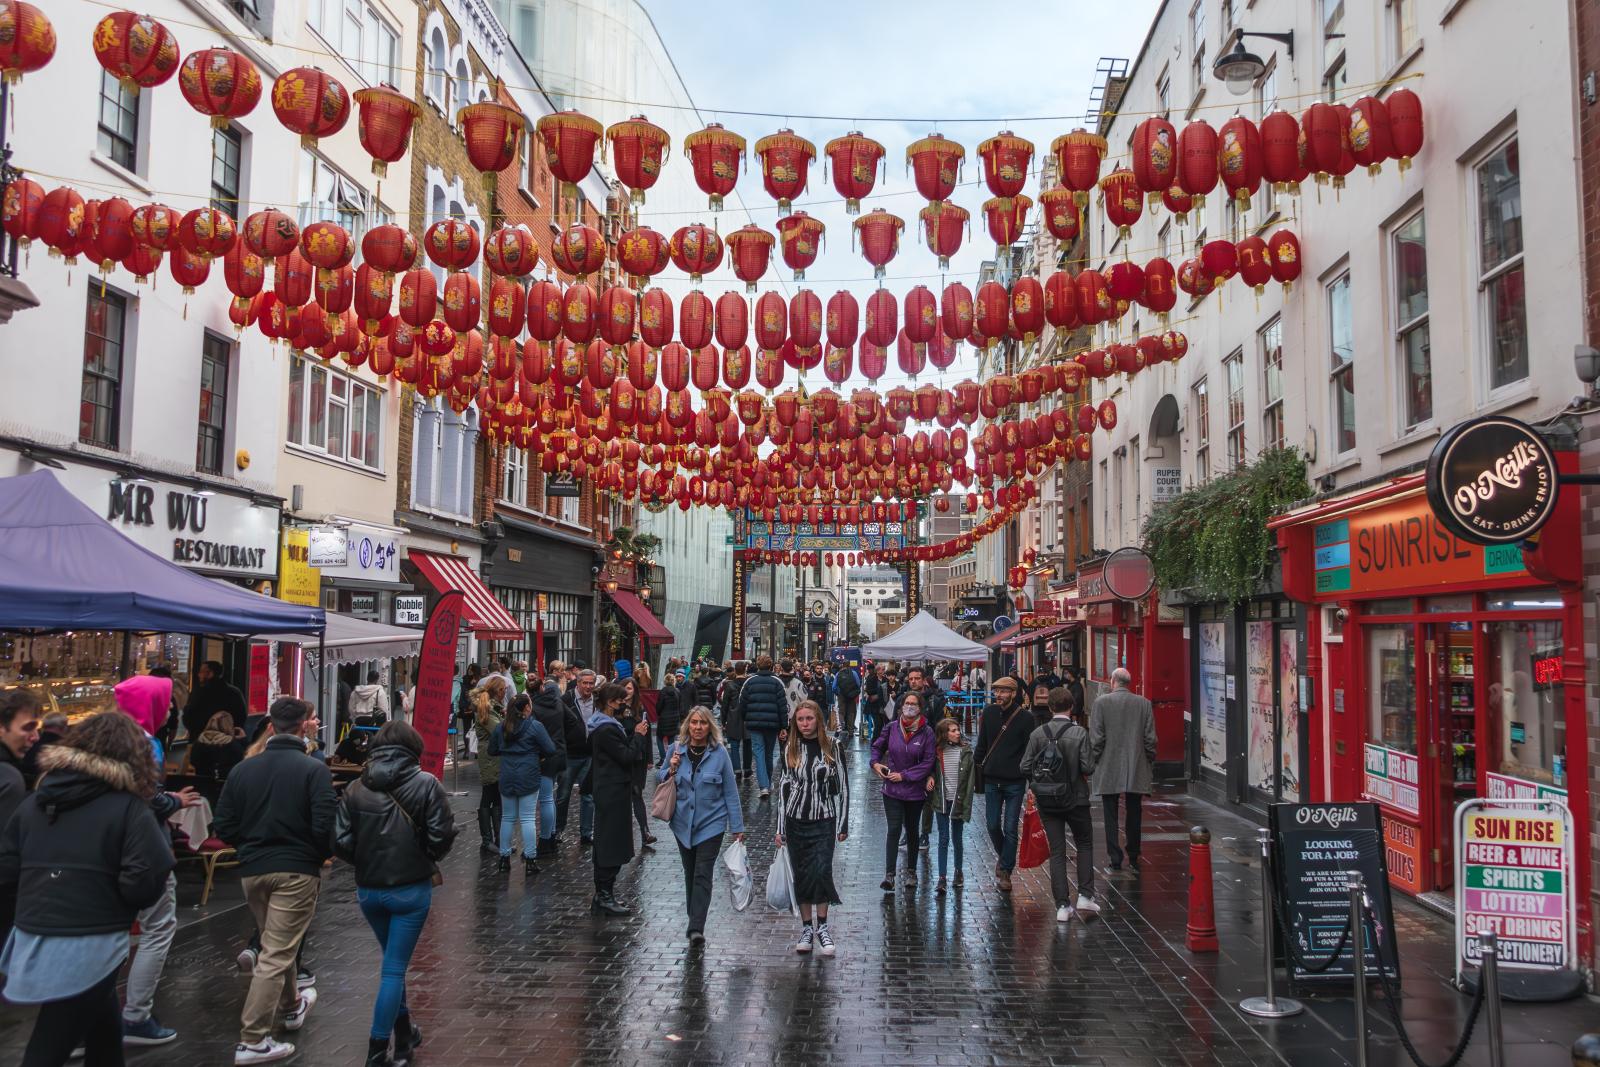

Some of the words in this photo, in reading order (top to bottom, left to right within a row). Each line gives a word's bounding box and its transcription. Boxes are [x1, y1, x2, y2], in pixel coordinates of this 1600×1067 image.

[1156, 469, 1181, 477] RUPER
[1156, 477, 1180, 485] COURT
[1454, 441, 1538, 516] O'Neill's
[107, 480, 154, 526] MR
[167, 491, 208, 534] WU
[1472, 516, 1494, 530] EAT
[1503, 508, 1536, 530] DRINK
[1535, 465, 1547, 502] ENJOY
[173, 538, 266, 569] RESTAURANT
[397, 599, 423, 610] Bubble
[406, 611, 420, 622] Tea
[1406, 758, 1418, 785] WIN
[1398, 785, 1418, 810] LOTTER
[1295, 807, 1358, 828] O'Neill's
[1390, 820, 1415, 848] OPEN
[1474, 817, 1510, 839] SUN
[1515, 820, 1554, 842] RISE
[1300, 851, 1322, 860] FOR
[1324, 851, 1333, 860] A
[1333, 850, 1359, 860] JOB?
[1304, 840, 1353, 849] LOOKING
[1469, 845, 1504, 864] BEER
[1507, 849, 1518, 865] &
[1520, 847, 1560, 867] WINE
[1482, 868, 1544, 890] SPIRITS
[1480, 892, 1546, 913] LOTTERY
[1466, 913, 1503, 933] SOFT
[1505, 918, 1561, 940] DRINKS
[1466, 938, 1562, 962] COECTIONERY
